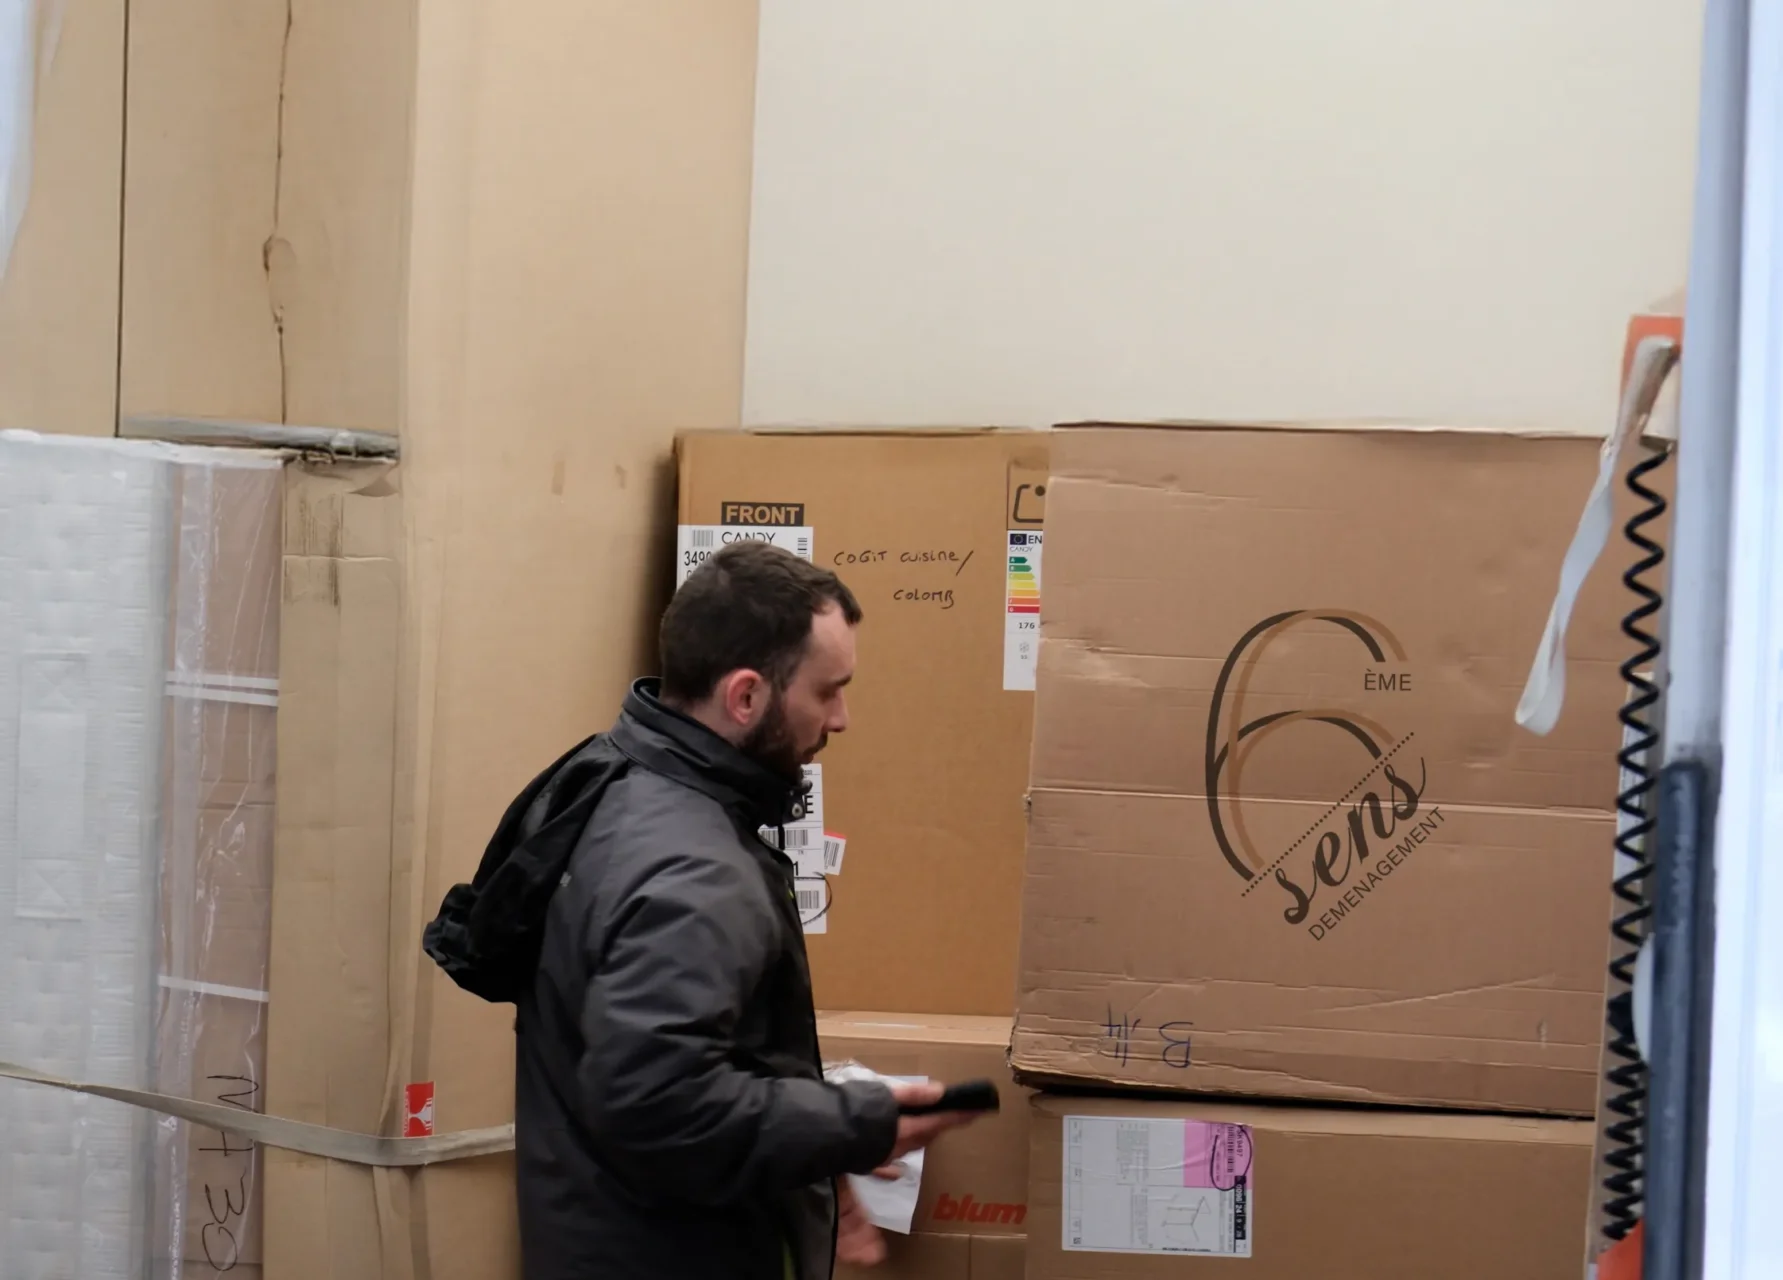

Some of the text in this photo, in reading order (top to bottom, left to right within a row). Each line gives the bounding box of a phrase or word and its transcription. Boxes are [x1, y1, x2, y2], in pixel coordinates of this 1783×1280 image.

[725, 505, 800, 524] FRONT
[1018, 622, 1035, 630] 176
[1204, 608, 1412, 883] 6 ÈME
[1274, 756, 1426, 925] sens
[1307, 806, 1447, 941] DEMENAGEMENT
[932, 1192, 1028, 1226] blum
